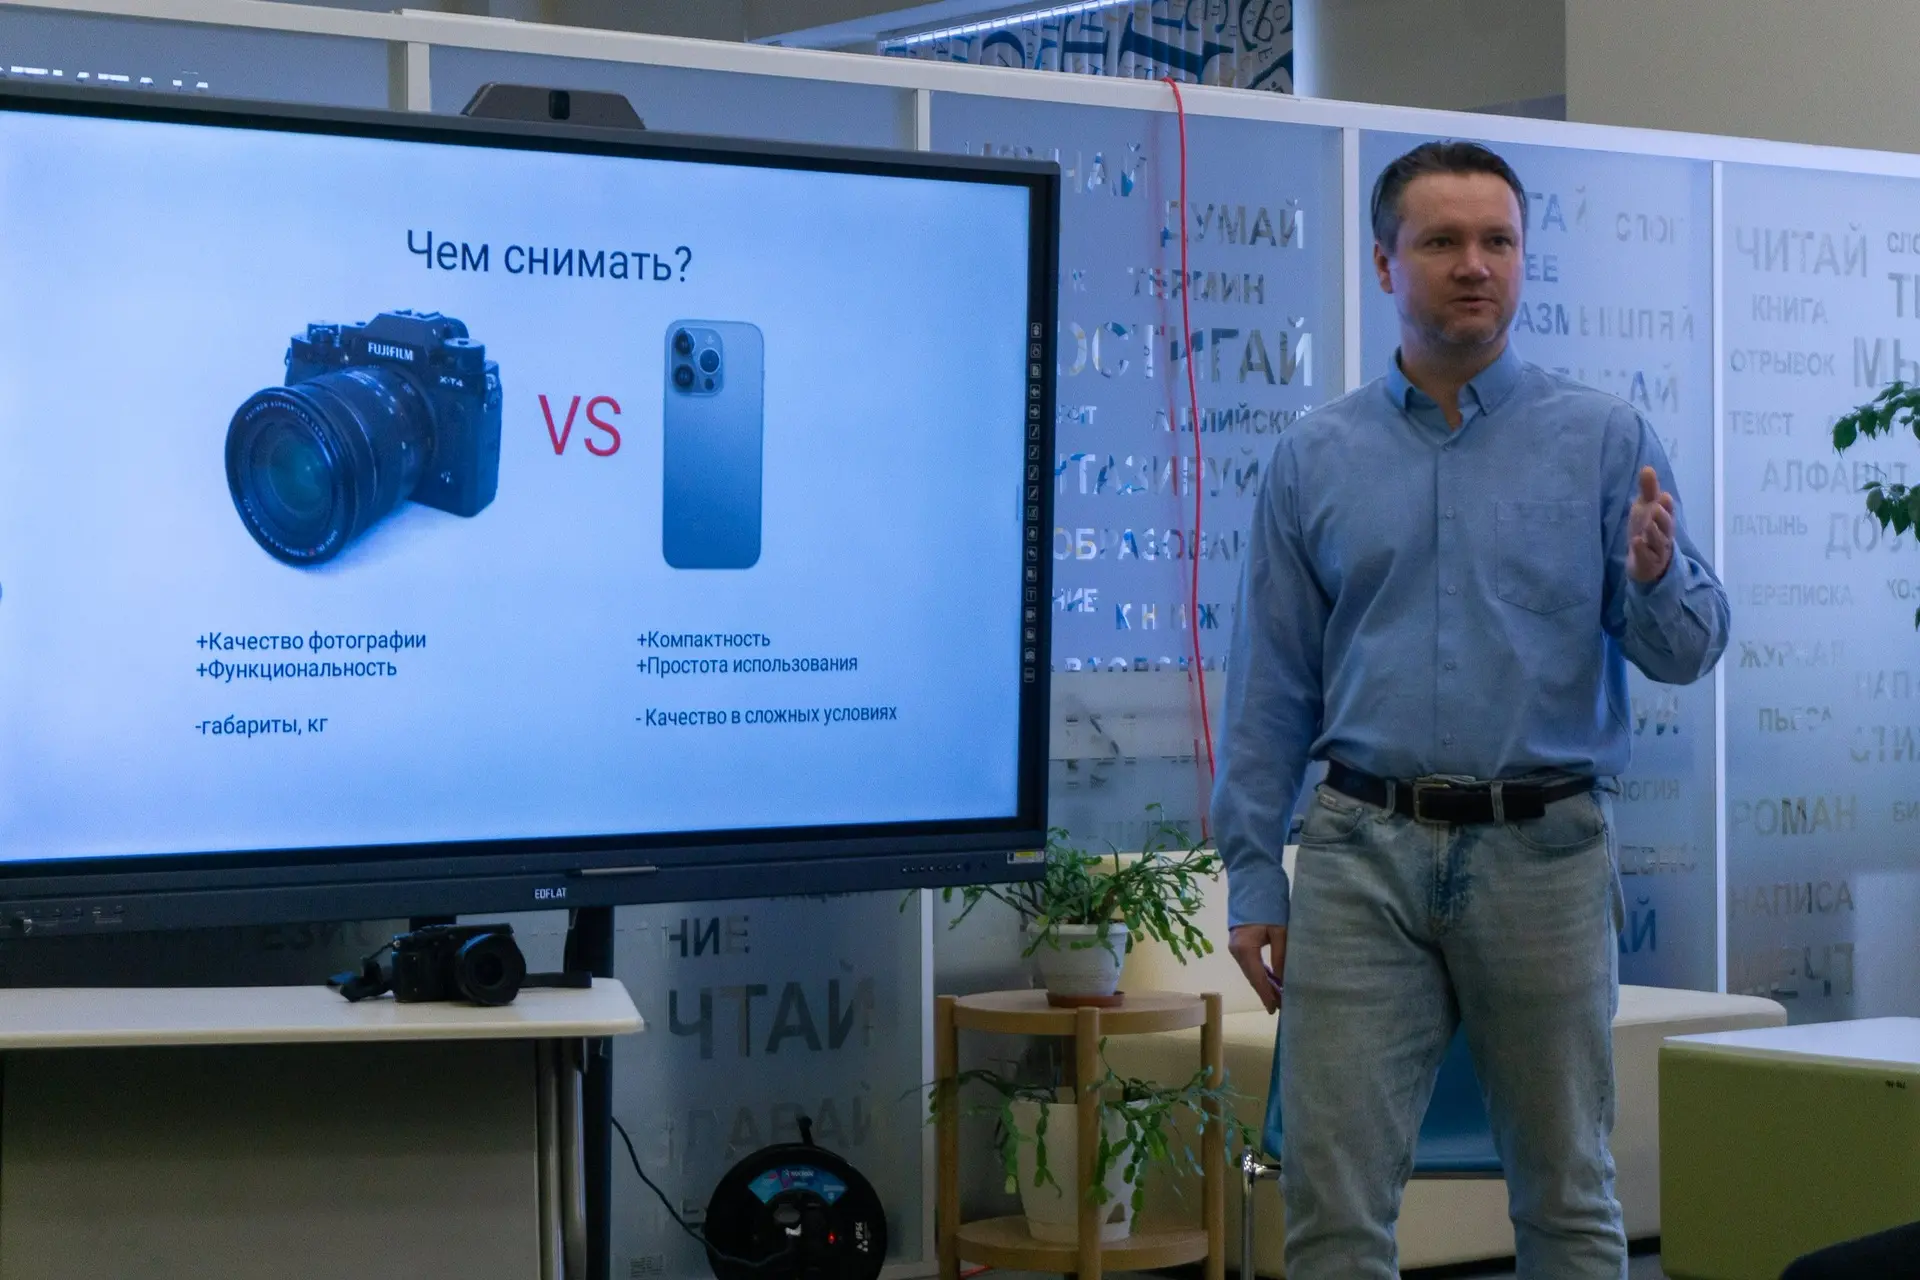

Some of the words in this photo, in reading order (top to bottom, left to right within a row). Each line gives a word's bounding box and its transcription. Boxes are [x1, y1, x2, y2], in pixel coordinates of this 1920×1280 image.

[407, 230, 489, 271] Чем
[504, 245, 692, 282] снимать?
[1736, 222, 1868, 278] ЧИТАЙ
[1752, 294, 1828, 326] КНИГА
[367, 342, 414, 361] FUJIFILM
[1730, 349, 1836, 377] ОТРЫВОК
[537, 394, 622, 457] VS
[196, 631, 303, 651] +Качество
[308, 630, 427, 654] фотографии
[636, 630, 771, 649] +Компактность
[196, 659, 397, 683] +Функциональность
[636, 656, 728, 679] +Простота
[733, 656, 858, 674] использования
[195, 714, 302, 739] -габариты,
[308, 718, 328, 733] кг
[646, 708, 727, 727] Качество
[731, 710, 741, 724] в
[745, 706, 819, 725] сложных
[823, 706, 898, 726] условиях
[534, 887, 568, 900] EDFLAT
